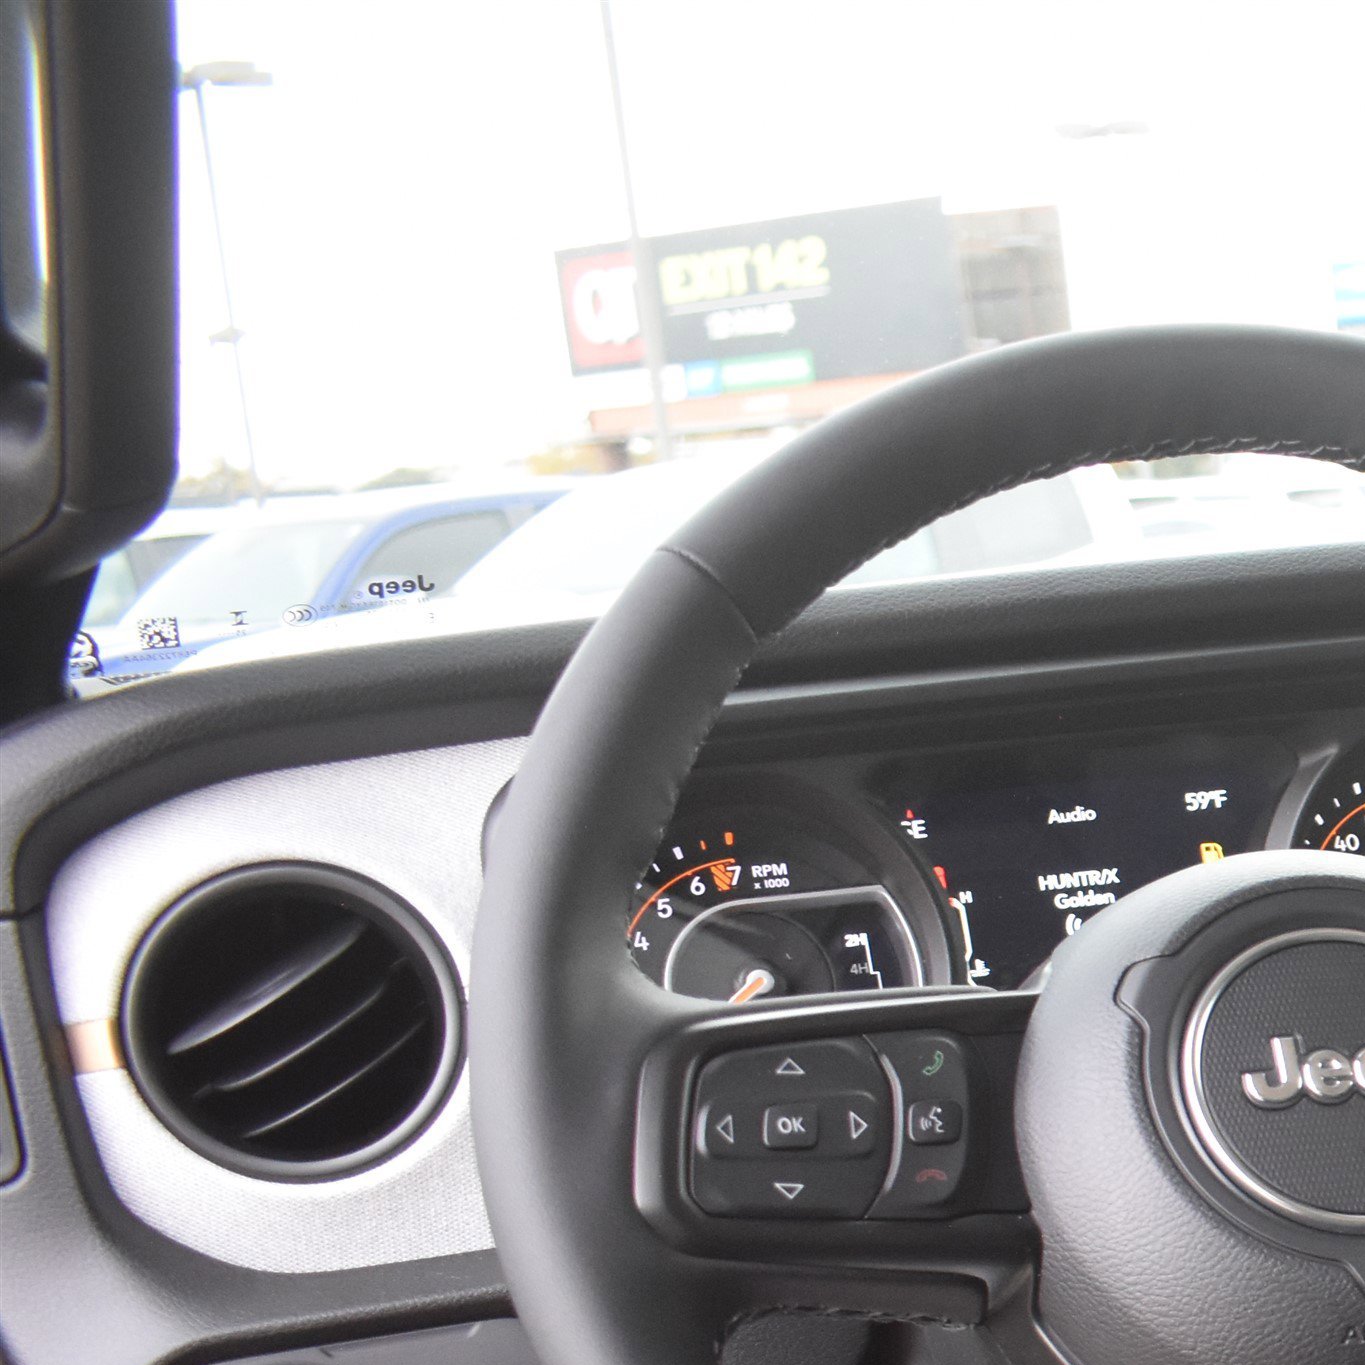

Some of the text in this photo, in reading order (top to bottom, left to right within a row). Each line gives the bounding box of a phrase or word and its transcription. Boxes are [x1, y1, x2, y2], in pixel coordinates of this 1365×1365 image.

[753, 235, 831, 292] 142
[1048, 806, 1097, 824] Audio
[1333, 833, 1360, 852] 40
[726, 865, 742, 886] 7
[751, 863, 788, 878] RPM
[690, 876, 706, 896] 6
[764, 877, 790, 889] 1000
[959, 891, 973, 904] H
[1054, 891, 1116, 910] Golden
[657, 898, 673, 919] 5
[633, 931, 649, 950] 4
[850, 963, 869, 975] 4H
[776, 1115, 806, 1134] OK
